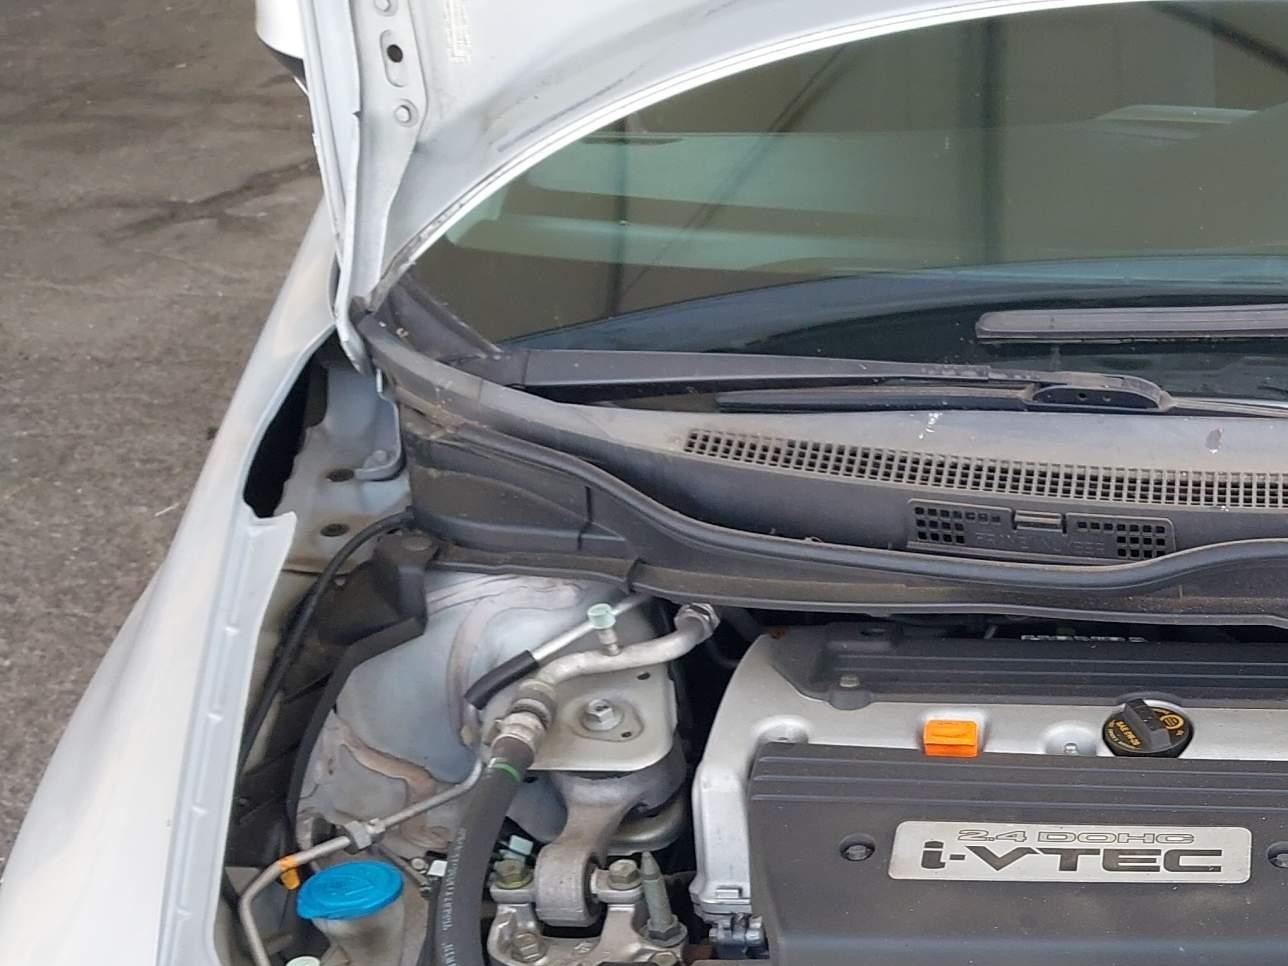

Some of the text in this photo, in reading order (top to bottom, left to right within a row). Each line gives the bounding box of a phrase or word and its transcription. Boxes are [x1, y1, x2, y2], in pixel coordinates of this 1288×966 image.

[957, 829, 1195, 844] 2.4 DOHC
[920, 840, 1222, 872] i-VTEC
